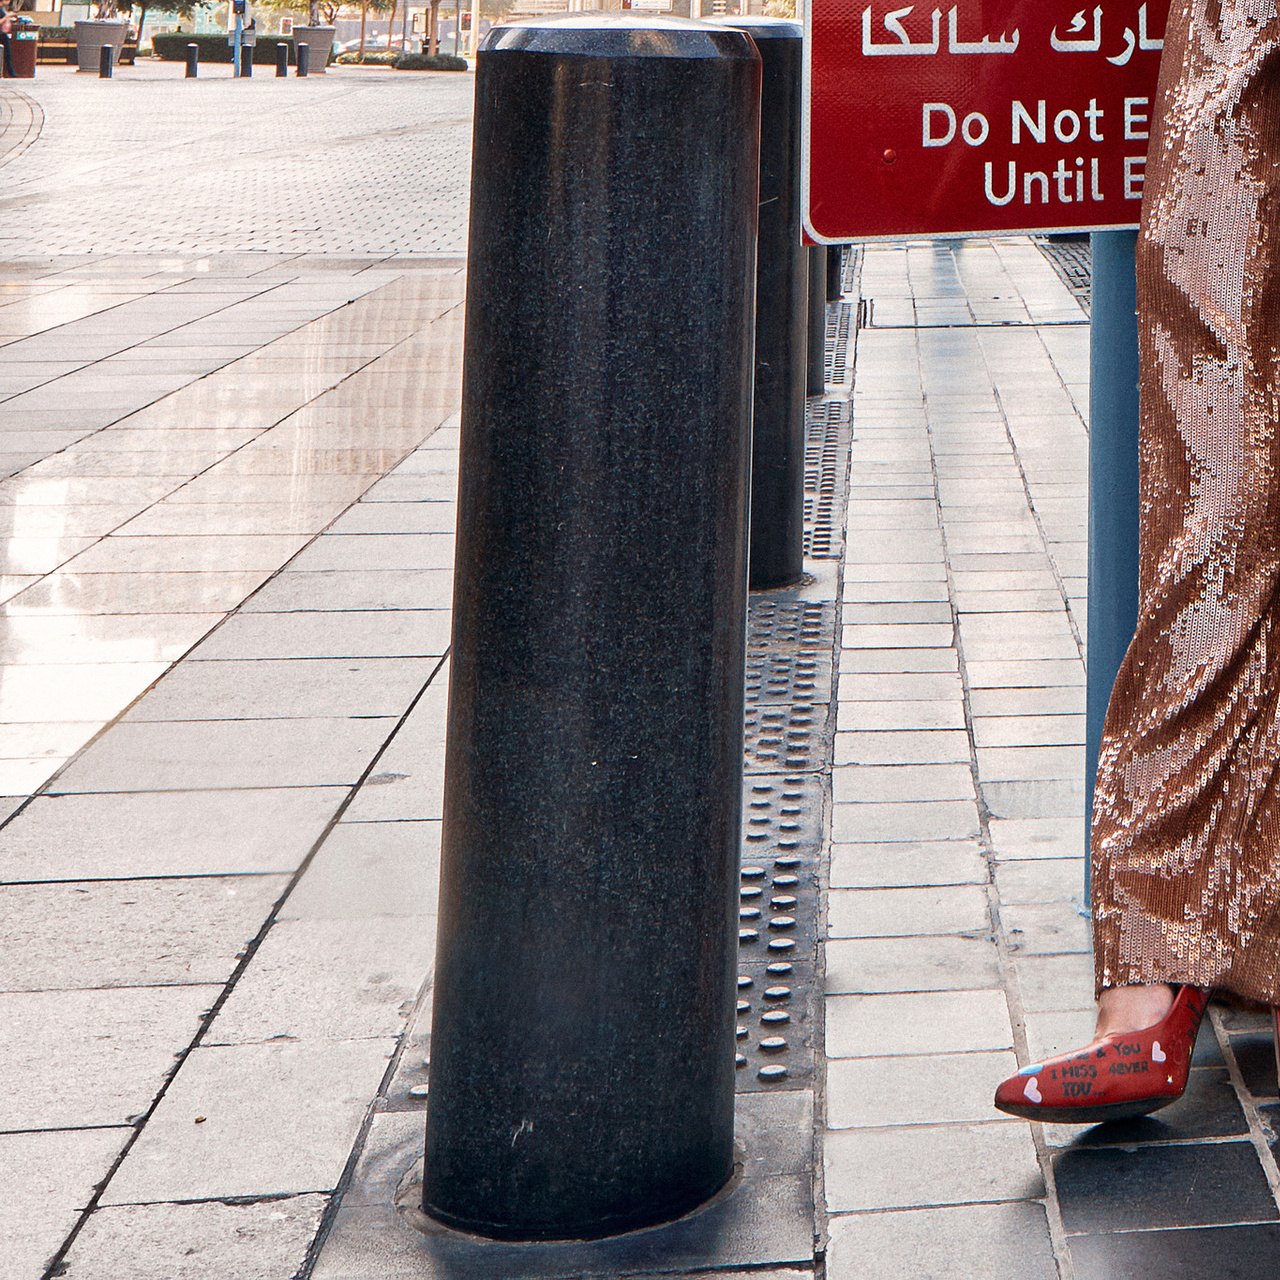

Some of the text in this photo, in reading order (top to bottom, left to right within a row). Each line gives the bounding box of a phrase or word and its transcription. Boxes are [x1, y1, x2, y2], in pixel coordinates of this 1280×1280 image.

[861, 4, 1020, 56] سالكا
[922, 102, 990, 148] Do
[1011, 97, 1104, 144] Not
[983, 157, 1104, 206] Until
[1051, 1064, 1098, 1080] I MISS
[1108, 1060, 1149, 1076] 4EVER
